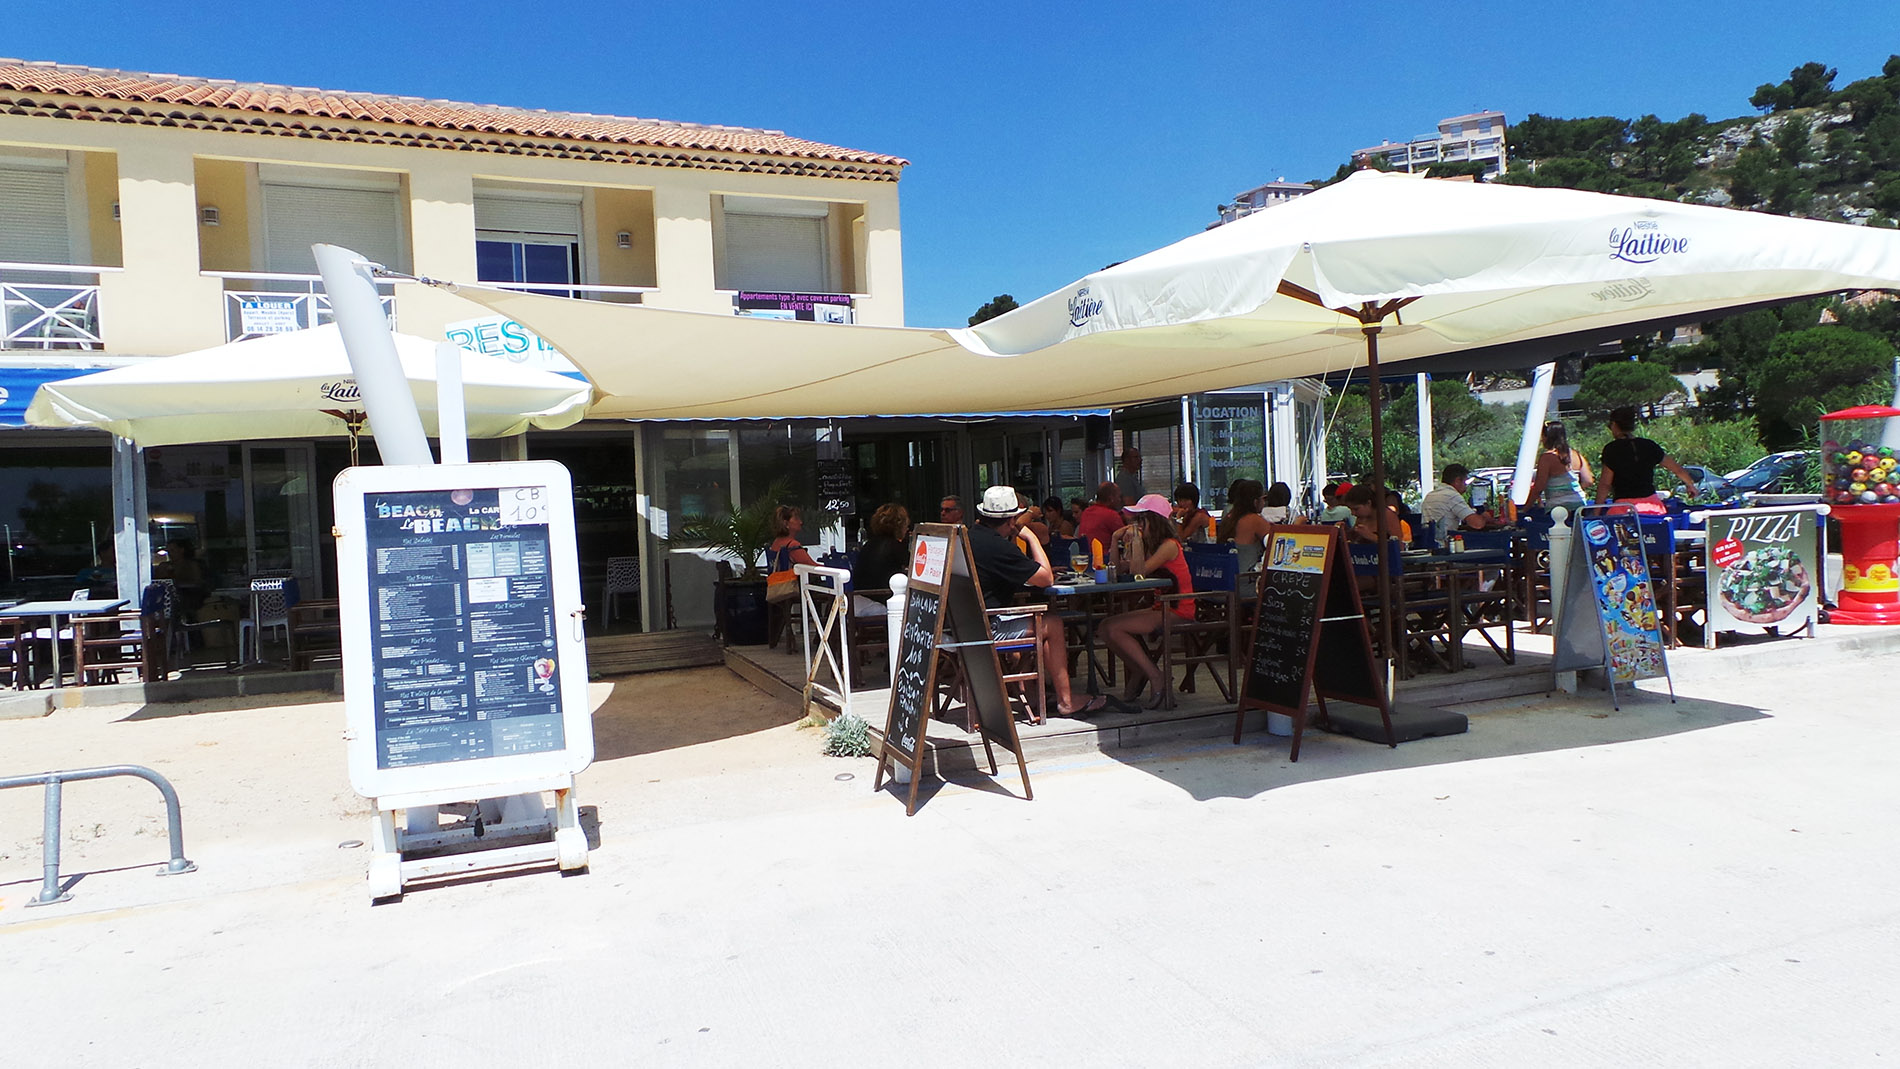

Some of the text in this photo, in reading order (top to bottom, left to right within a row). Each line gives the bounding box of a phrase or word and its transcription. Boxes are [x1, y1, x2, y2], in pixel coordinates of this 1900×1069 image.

[1609, 227, 1689, 264] Laitière
[740, 291, 778, 301] Appartements
[791, 293, 796, 301] 3
[830, 296, 850, 304] parking
[780, 302, 788, 310] EN
[1196, 406, 1258, 418] LOCATION
[481, 506, 500, 514] CAR
[1726, 512, 1802, 543] PIZZA
[910, 591, 939, 615] SALADE
